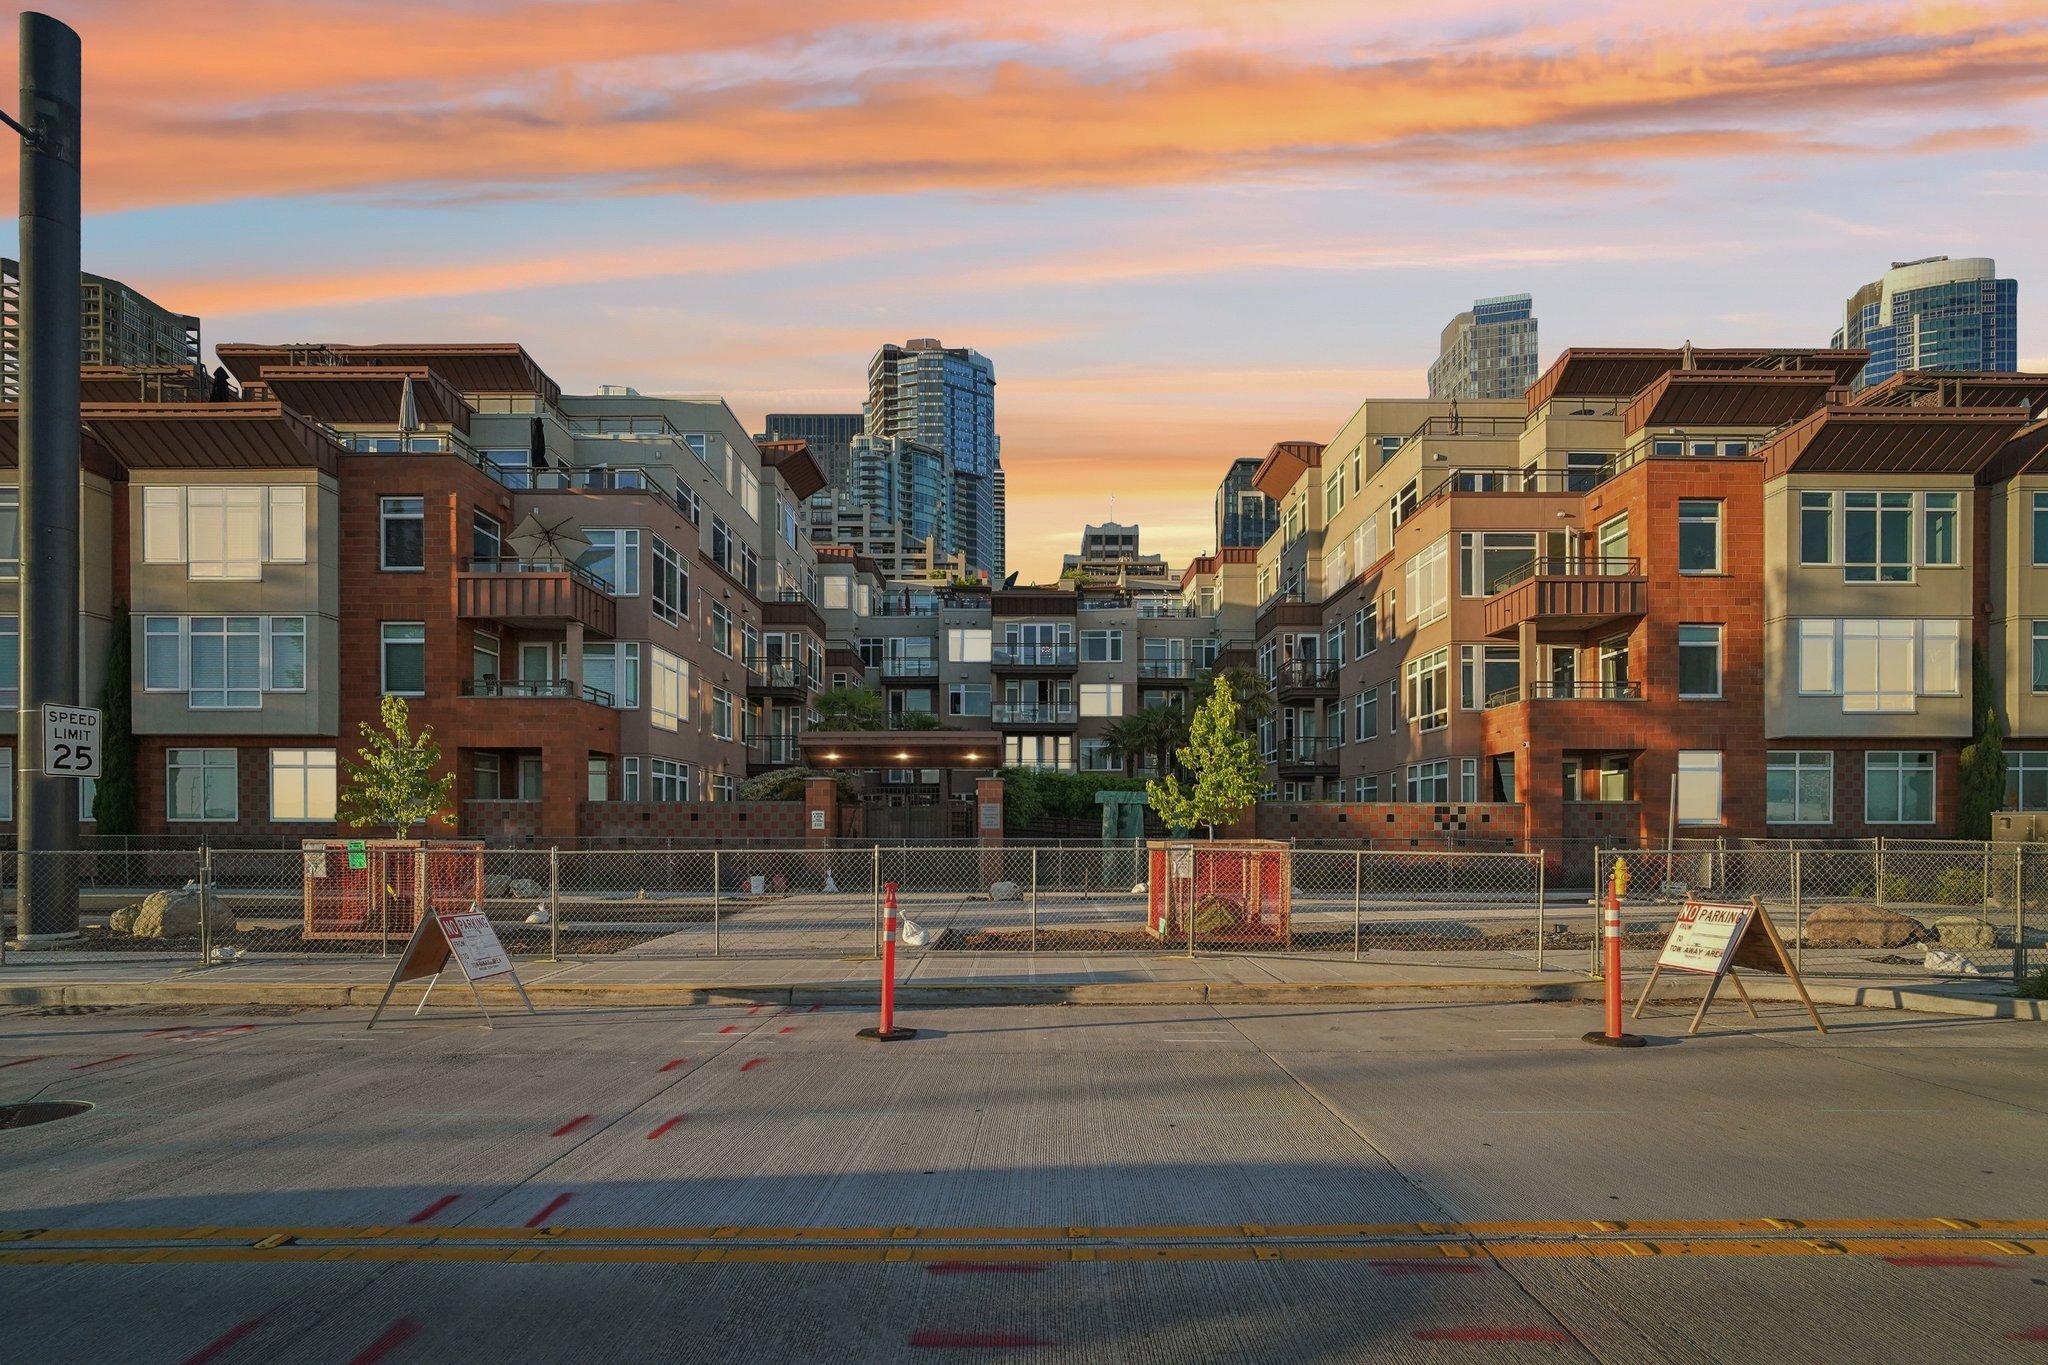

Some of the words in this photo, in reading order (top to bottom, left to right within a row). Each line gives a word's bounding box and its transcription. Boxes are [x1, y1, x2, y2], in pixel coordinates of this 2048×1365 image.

[49, 711, 96, 726] SPEED
[54, 728, 91, 741] LIMIT
[53, 744, 93, 770] 25
[1679, 905, 1699, 920] NO
[1699, 909, 1742, 924] PARKING
[443, 920, 459, 935] NO
[457, 917, 488, 930] PARKING
[1670, 944, 1682, 952] TOW
[1683, 947, 1703, 955] AWAY
[1705, 950, 1723, 958] AREA
